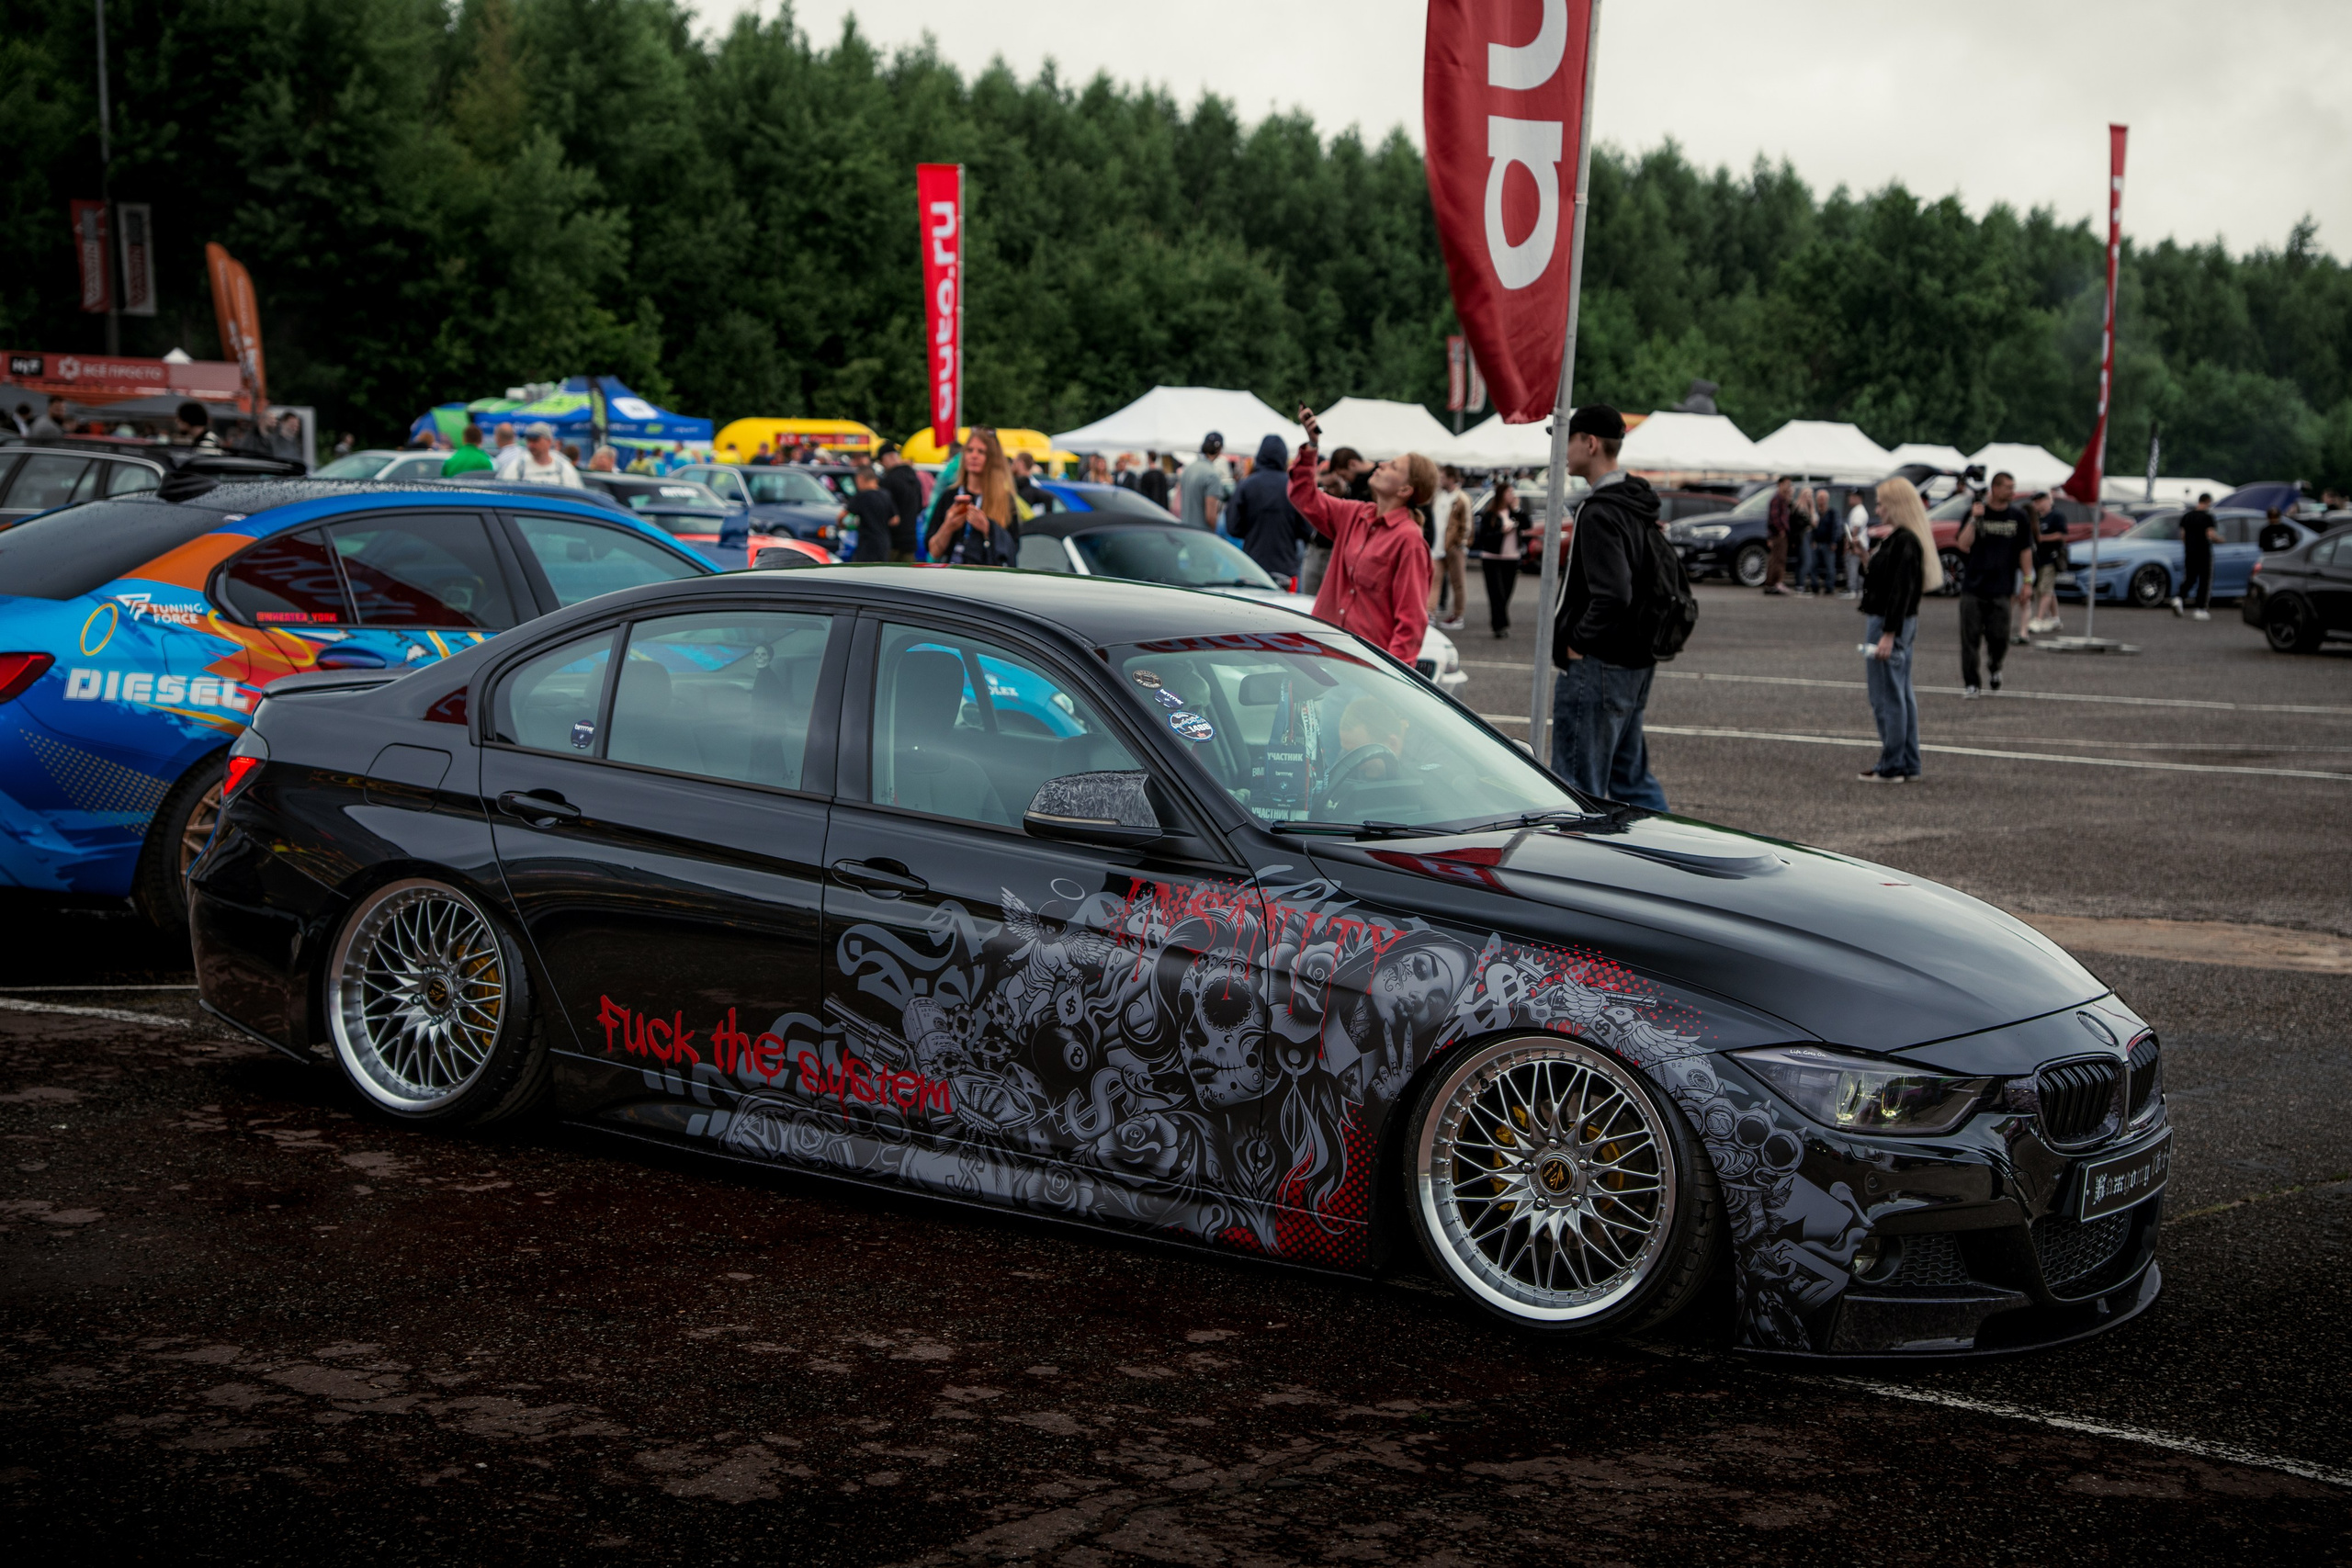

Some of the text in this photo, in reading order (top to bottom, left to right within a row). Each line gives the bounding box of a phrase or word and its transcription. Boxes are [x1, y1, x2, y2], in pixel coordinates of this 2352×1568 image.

[929, 200, 956, 422] auto.ru
[150, 603, 203, 614] TUNING
[153, 613, 198, 625] FORCE
[64, 667, 249, 709] DIESEL
[1267, 752, 1304, 762] УЧАСТНИК
[1251, 807, 1289, 821] УЧАСТНИК
[710, 1007, 786, 1087] the
[797, 1048, 953, 1122] system
